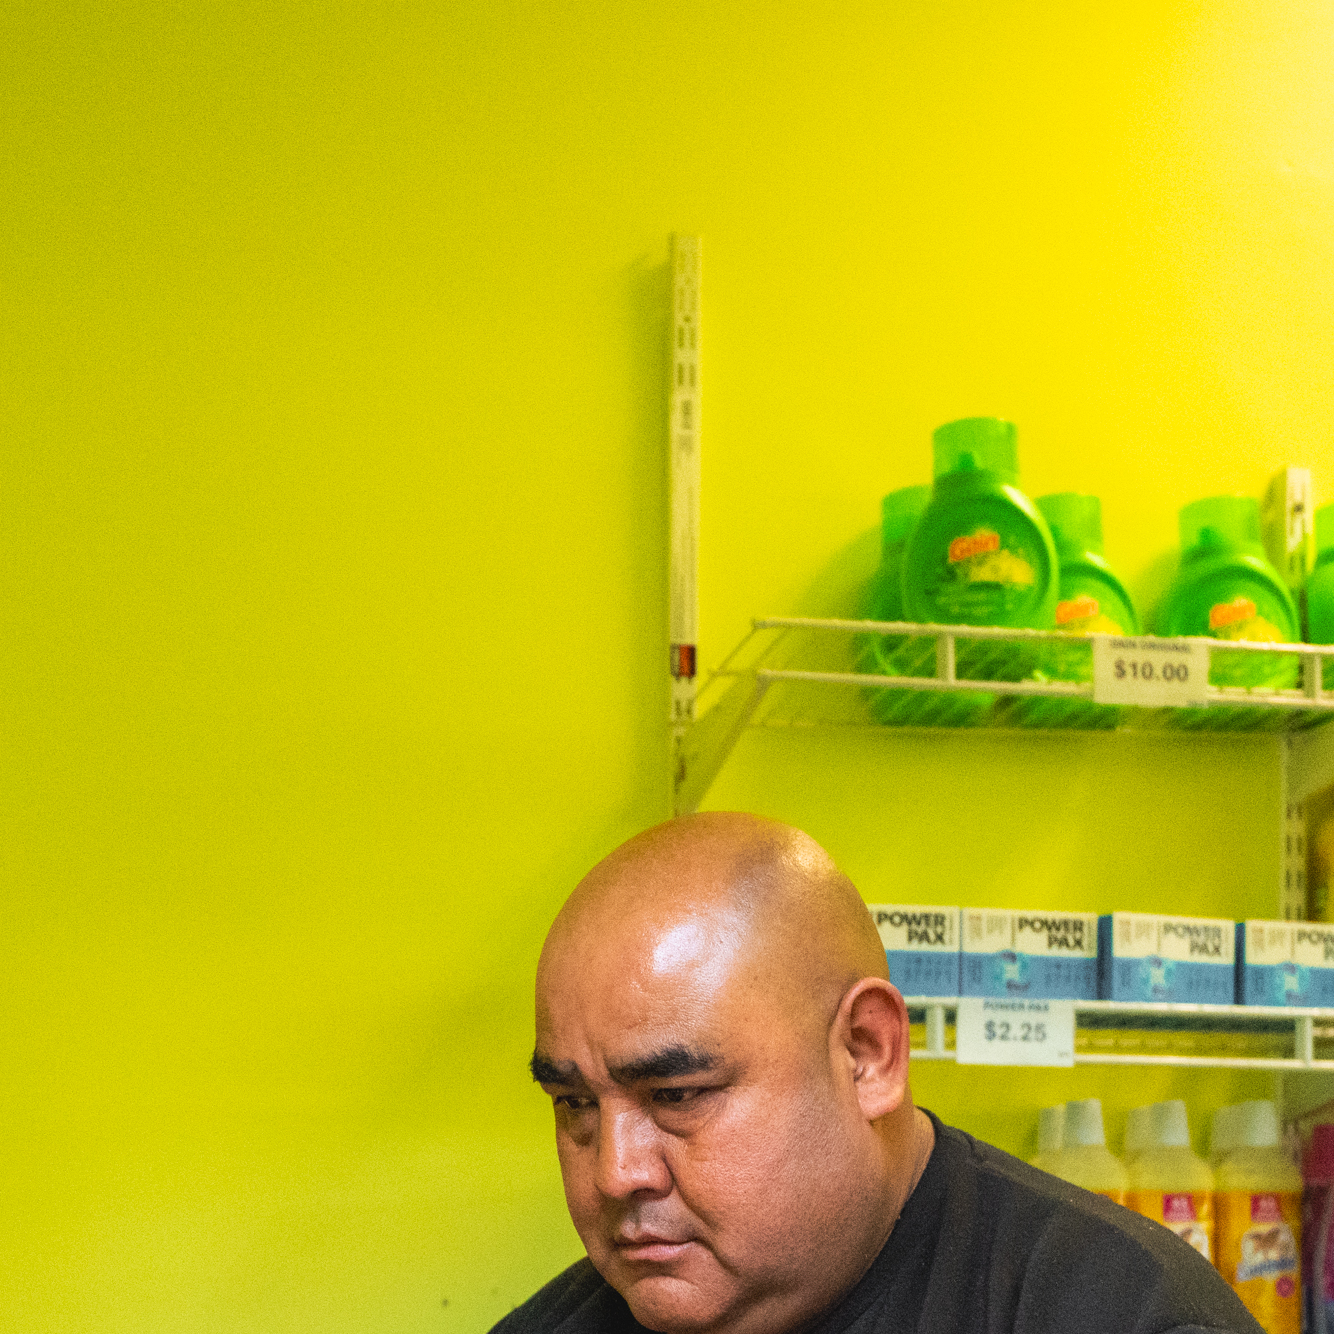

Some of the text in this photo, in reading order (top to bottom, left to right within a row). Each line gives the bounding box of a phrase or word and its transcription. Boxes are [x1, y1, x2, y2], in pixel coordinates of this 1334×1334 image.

[1114, 658, 1189, 682] $10.00
[876, 911, 946, 930] POWER
[1017, 916, 1085, 935] POWER
[906, 926, 946, 946] PAX
[1047, 931, 1084, 951] PAX
[1162, 923, 1224, 941] POWER
[1188, 938, 1223, 958] PAX
[984, 1020, 1047, 1042] $2.25
